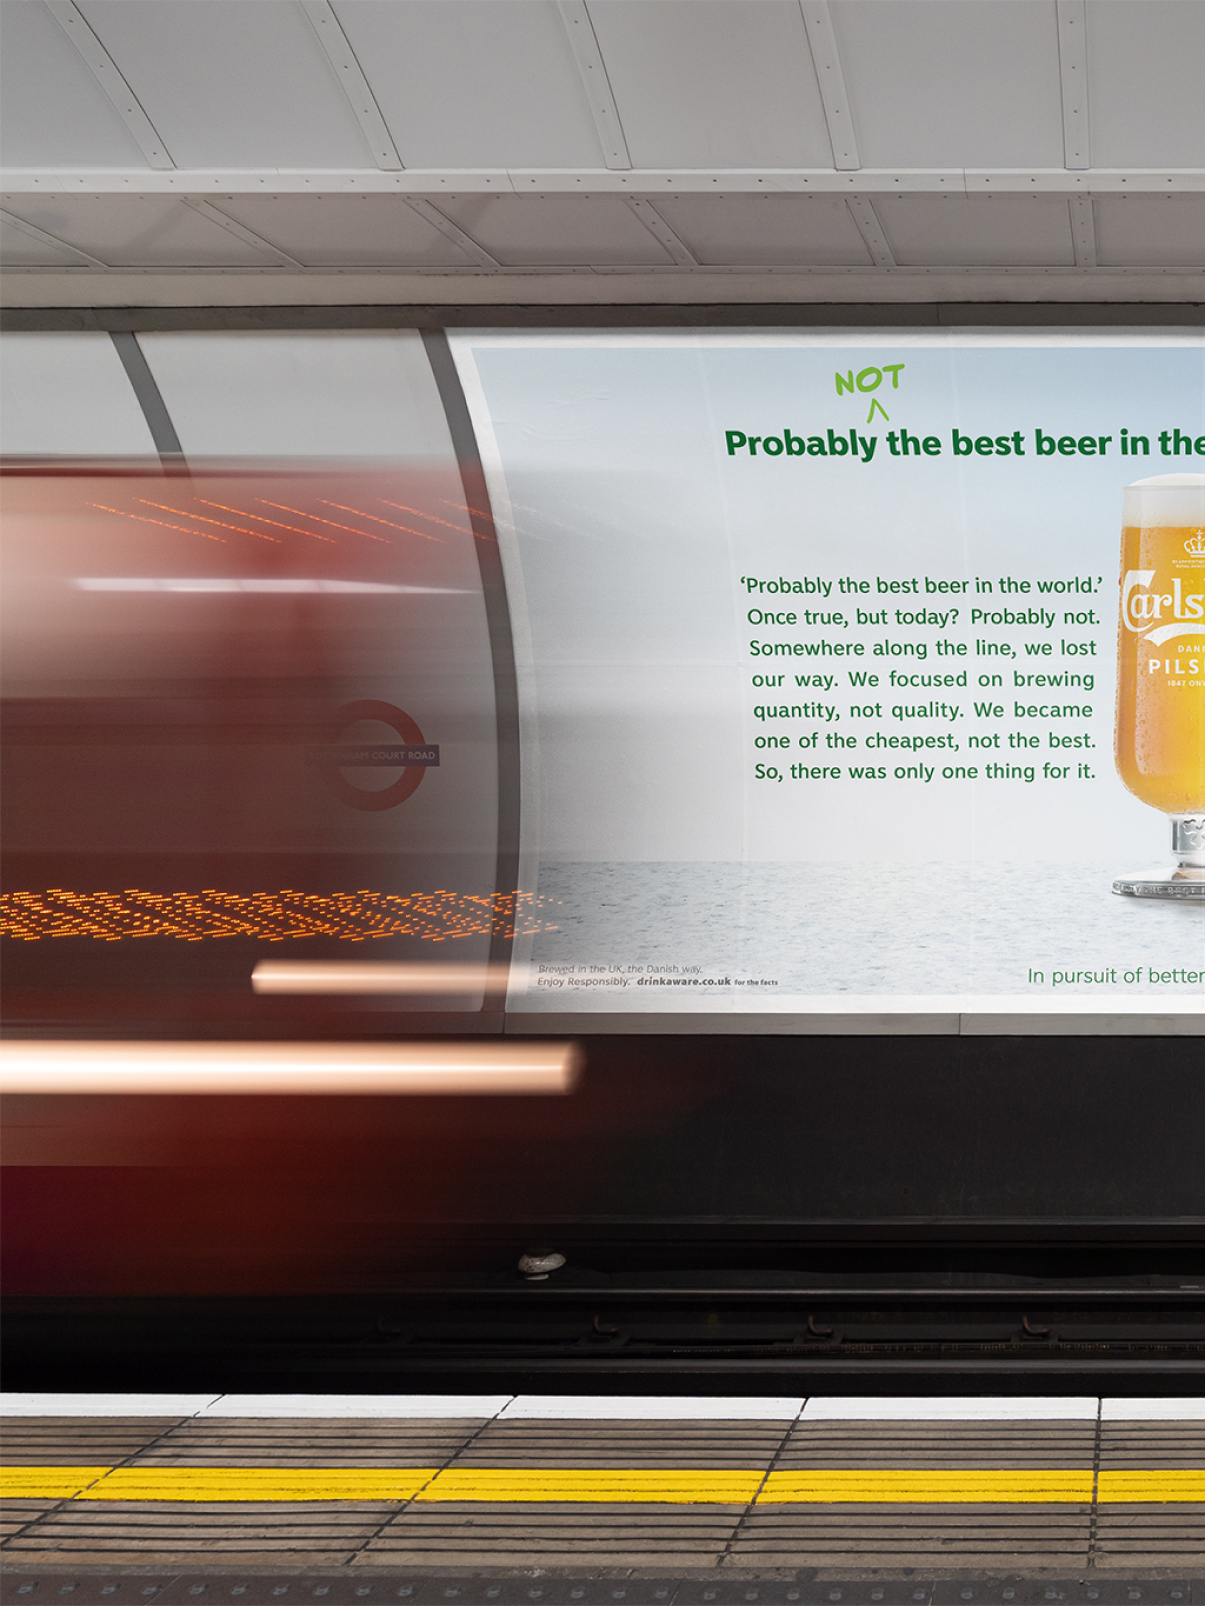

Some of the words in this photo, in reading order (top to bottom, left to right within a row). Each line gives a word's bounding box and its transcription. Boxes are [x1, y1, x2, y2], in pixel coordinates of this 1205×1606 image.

[834, 363, 906, 397] NOT
[724, 428, 878, 464] Probably
[885, 428, 942, 457] the
[951, 428, 1026, 457] best
[1034, 428, 1113, 457] beer
[1119, 427, 1151, 456] in
[740, 575, 833, 598] ‘Probably
[837, 576, 871, 594] the
[876, 576, 920, 594] best
[924, 576, 970, 594] beer
[974, 576, 993, 594] in
[998, 576, 1032, 594] the
[1036, 576, 1103, 594] world.’
[747, 608, 798, 626] Once
[803, 609, 849, 629] true,
[856, 607, 889, 625] but
[894, 607, 960, 629] today?
[971, 607, 1056, 629] Probably
[1063, 608, 1101, 625] not.
[749, 639, 865, 657] Somewhere
[872, 638, 928, 661] along
[935, 638, 968, 656] the
[976, 638, 1017, 660] line,
[1024, 642, 1053, 656] we
[1060, 638, 1097, 656] lost
[751, 674, 786, 688] our
[794, 674, 839, 692] way.
[847, 671, 880, 688] We
[888, 669, 968, 688] focused
[978, 674, 1003, 688] on
[1013, 670, 1095, 692] brewing
[753, 701, 840, 722] quantity,
[850, 702, 883, 718] not
[891, 700, 964, 722] quality.
[973, 701, 1005, 718] We
[1014, 700, 1093, 718] became
[754, 736, 791, 749] one
[798, 731, 819, 749] of
[825, 732, 858, 749] the
[865, 731, 960, 753] cheapest,
[968, 733, 1001, 749] not
[1007, 731, 1040, 749] the
[1048, 731, 1096, 749] best.
[371, 750, 405, 760] COURT
[407, 750, 436, 760] ROAD
[754, 763, 784, 783] So,
[789, 762, 842, 780] there
[848, 766, 887, 780] was
[893, 762, 935, 783] only
[941, 766, 979, 780] one
[984, 762, 1035, 783] thing
[1042, 761, 1071, 779] for
[1077, 762, 1096, 779] it.
[538, 964, 575, 974] Brewed
[578, 964, 587, 974] in
[589, 965, 607, 974] the
[608, 965, 626, 975] UK,
[627, 964, 645, 974] the
[646, 964, 680, 974] Danish
[681, 966, 703, 975] way.
[1028, 968, 1045, 983] In
[1052, 967, 1118, 987] pursuit
[1123, 966, 1143, 984] of
[1149, 967, 1205, 984] better
[537, 977, 566, 988] Enjoy
[568, 977, 631, 988] Responsibly.
[637, 977, 731, 987] drinkaware.co.uk
